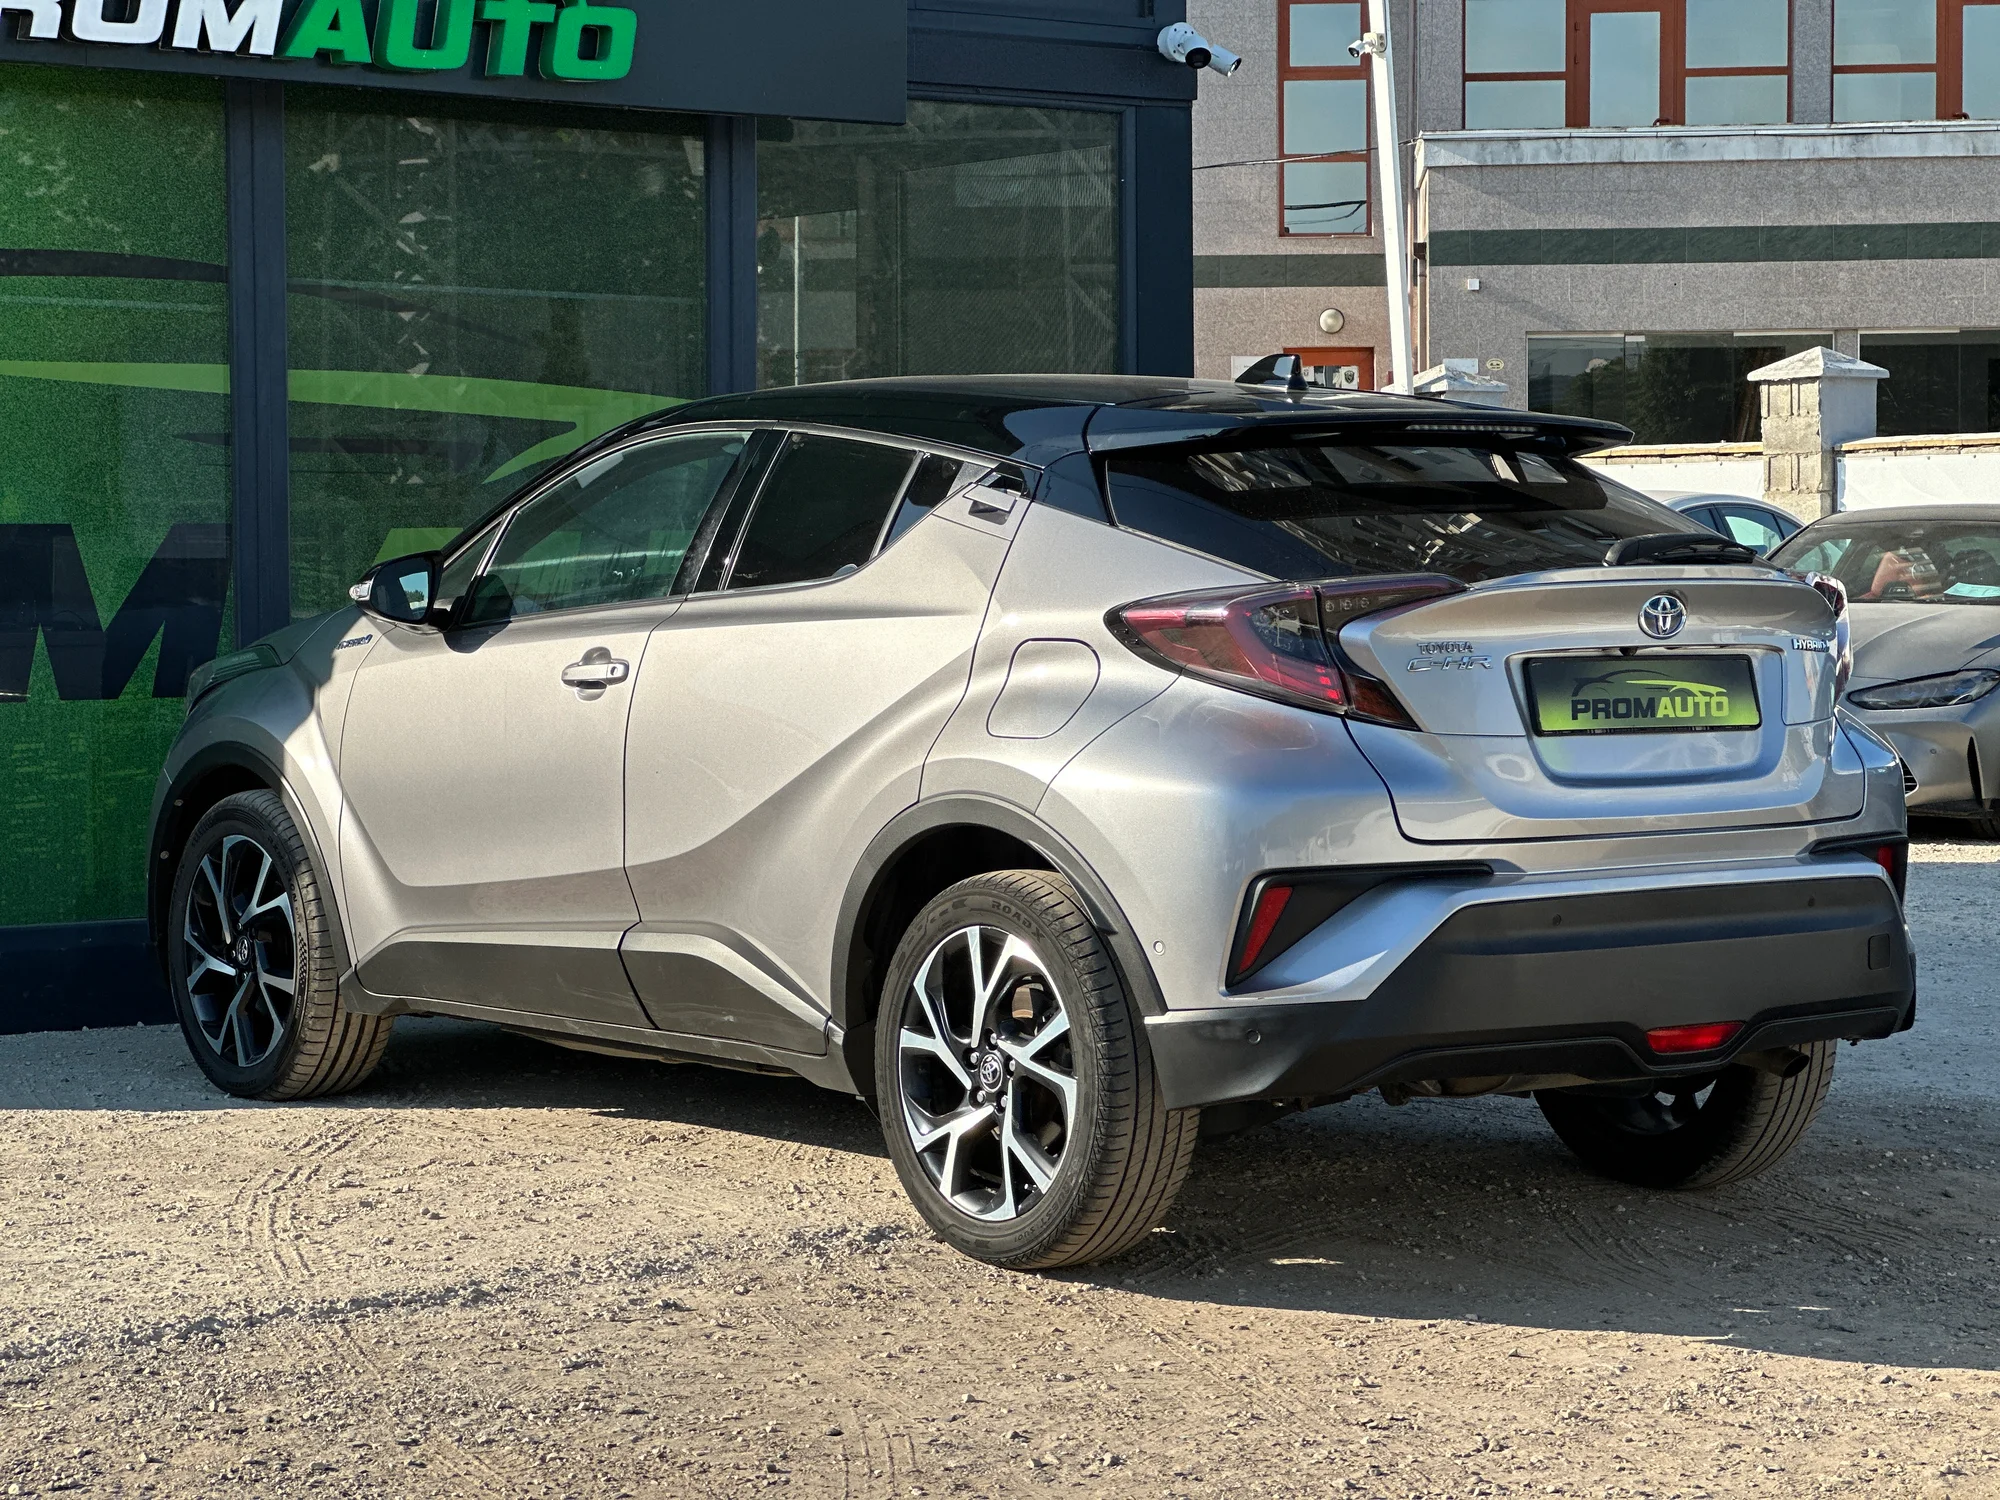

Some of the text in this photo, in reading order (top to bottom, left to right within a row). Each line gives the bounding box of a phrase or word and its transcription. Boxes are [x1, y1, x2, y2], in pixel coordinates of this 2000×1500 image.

[1416, 641, 1474, 655] TOYOTA
[1792, 638, 1828, 653] HYBRID
[1407, 655, 1492, 672] C-HR
[1571, 695, 1729, 721] PROMAUTO
[991, 900, 1046, 941] ROADX
